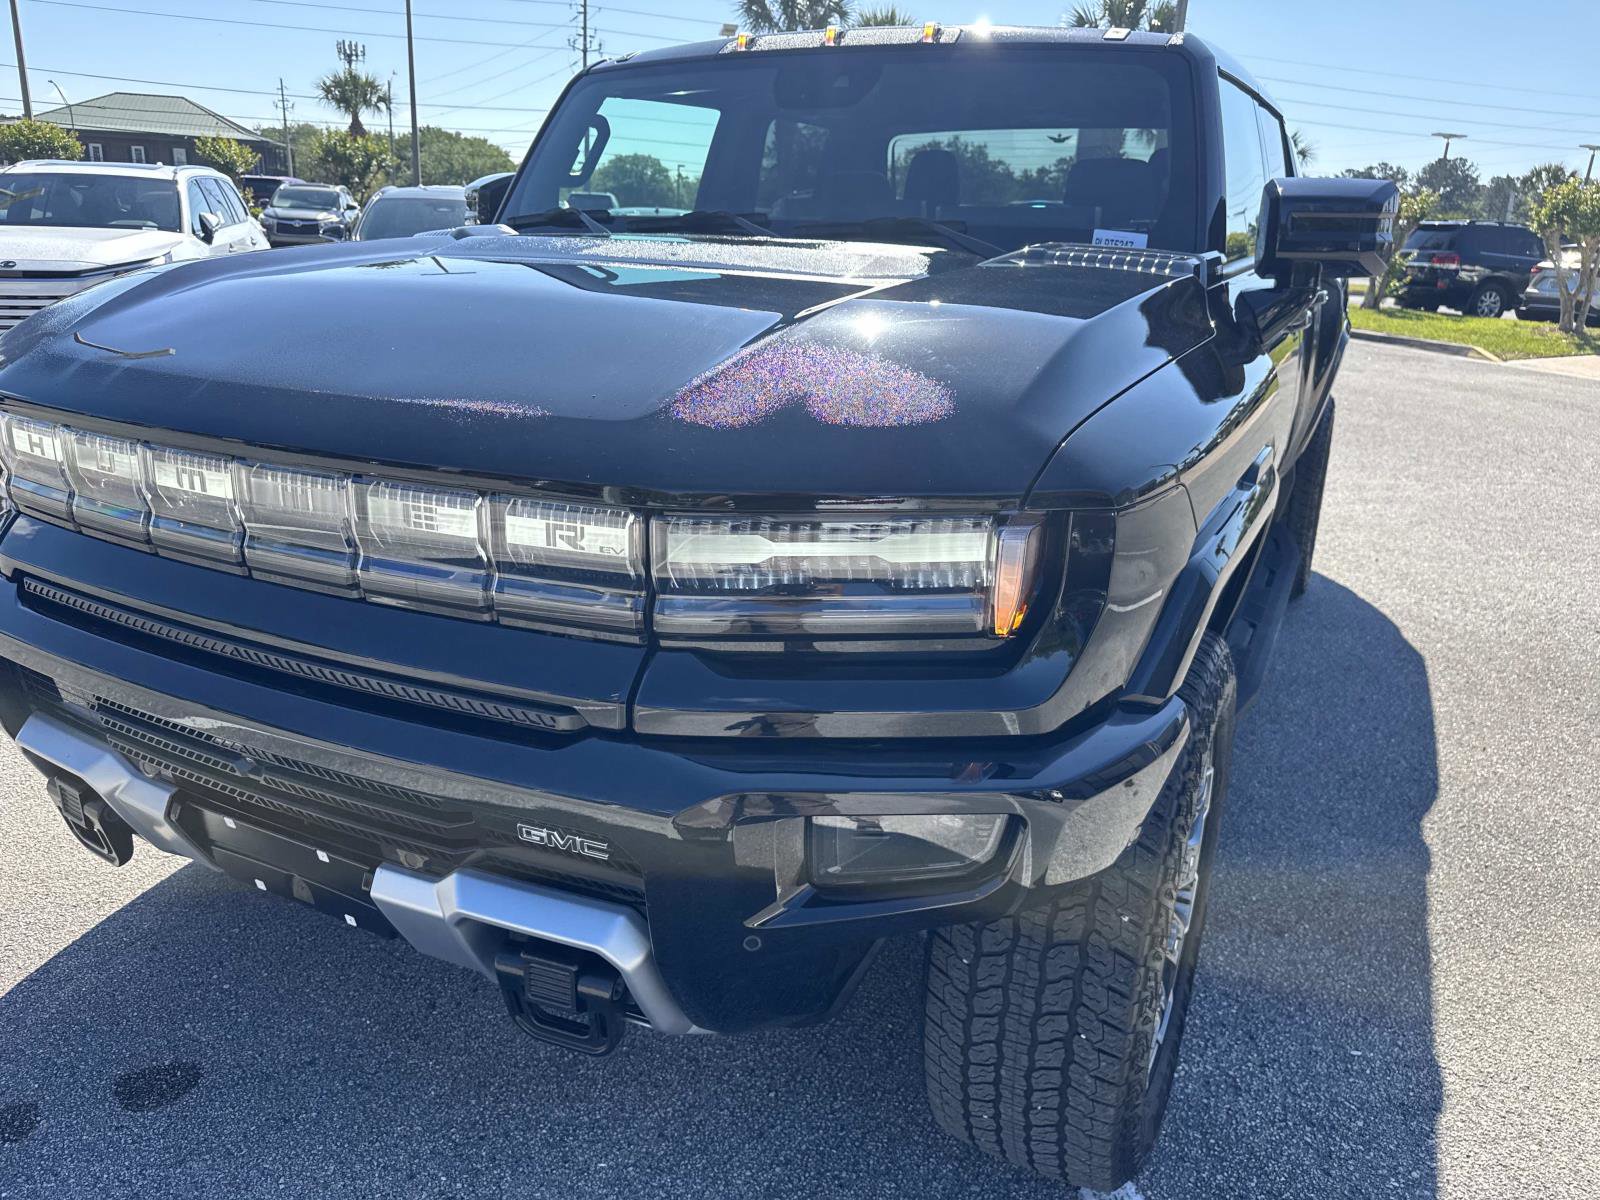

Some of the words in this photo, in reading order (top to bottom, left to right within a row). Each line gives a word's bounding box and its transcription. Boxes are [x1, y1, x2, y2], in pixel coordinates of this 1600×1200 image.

[28, 433, 585, 550] HUMER
[599, 545, 625, 555] EV
[517, 823, 609, 860] GMC
